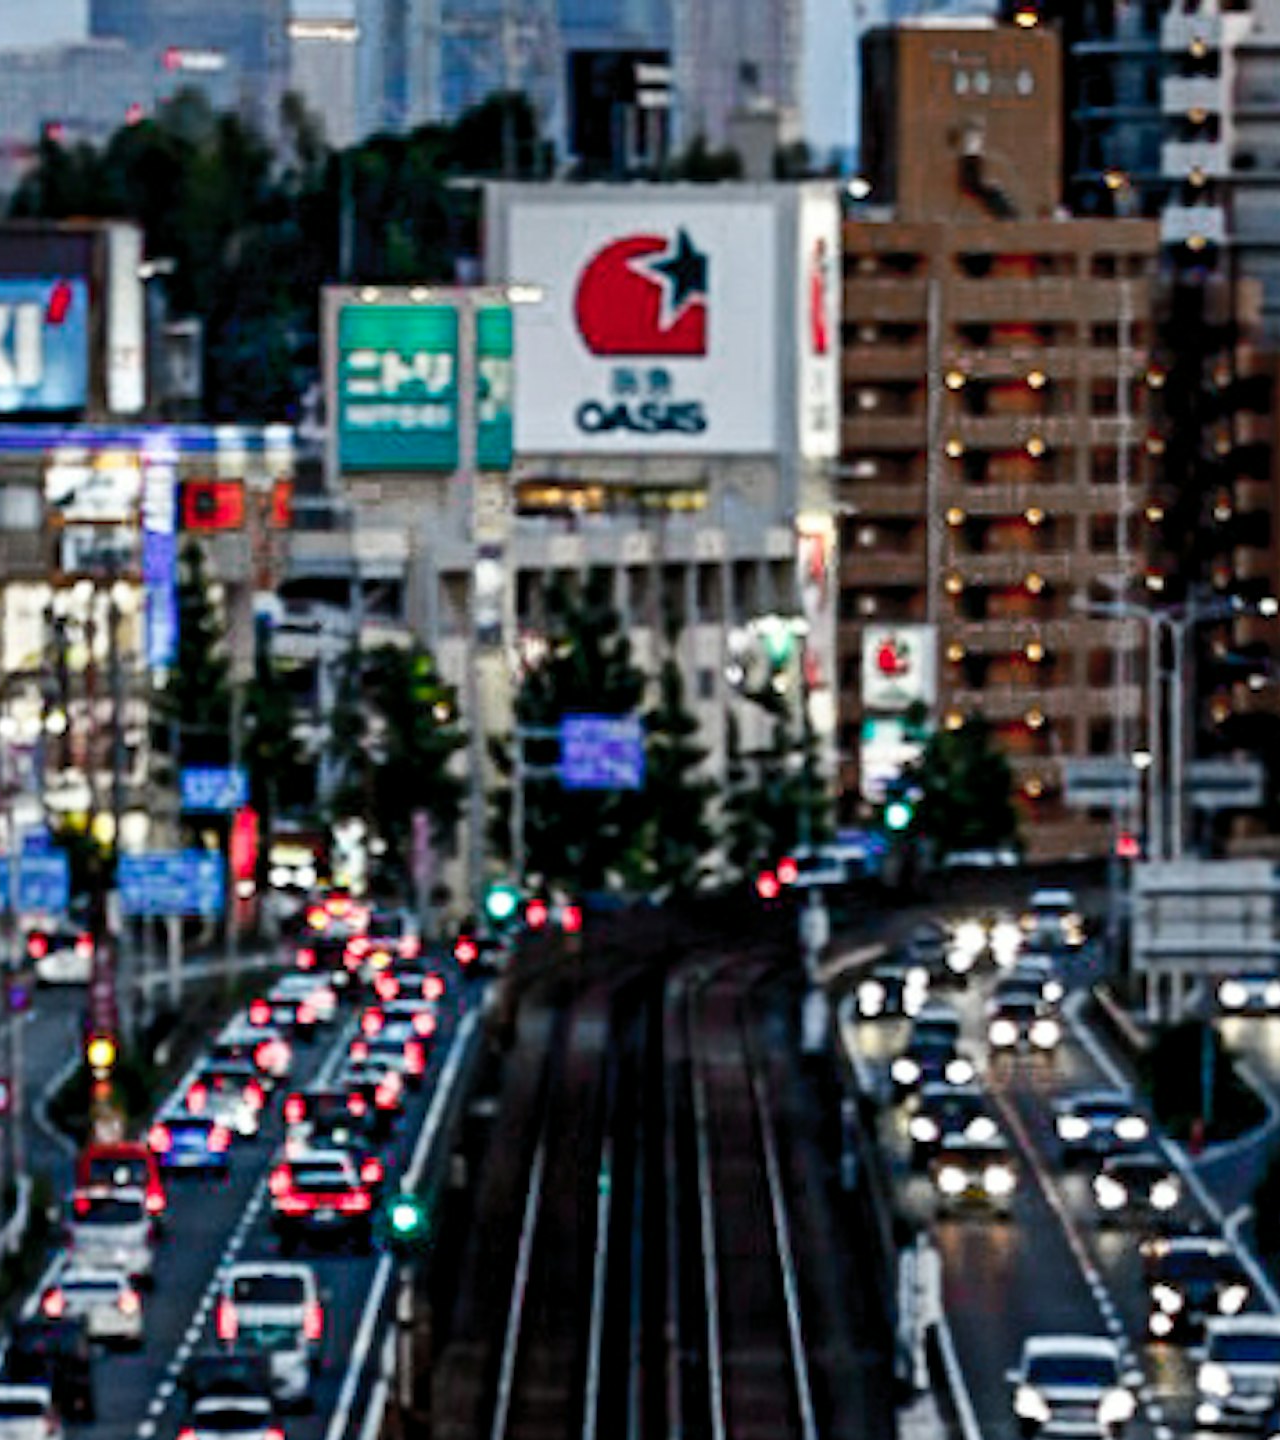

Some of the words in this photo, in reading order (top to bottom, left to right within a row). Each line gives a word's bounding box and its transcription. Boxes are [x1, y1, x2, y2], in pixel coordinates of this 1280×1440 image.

[345, 347, 454, 396] ニトリ
[575, 399, 706, 435] OASIS
